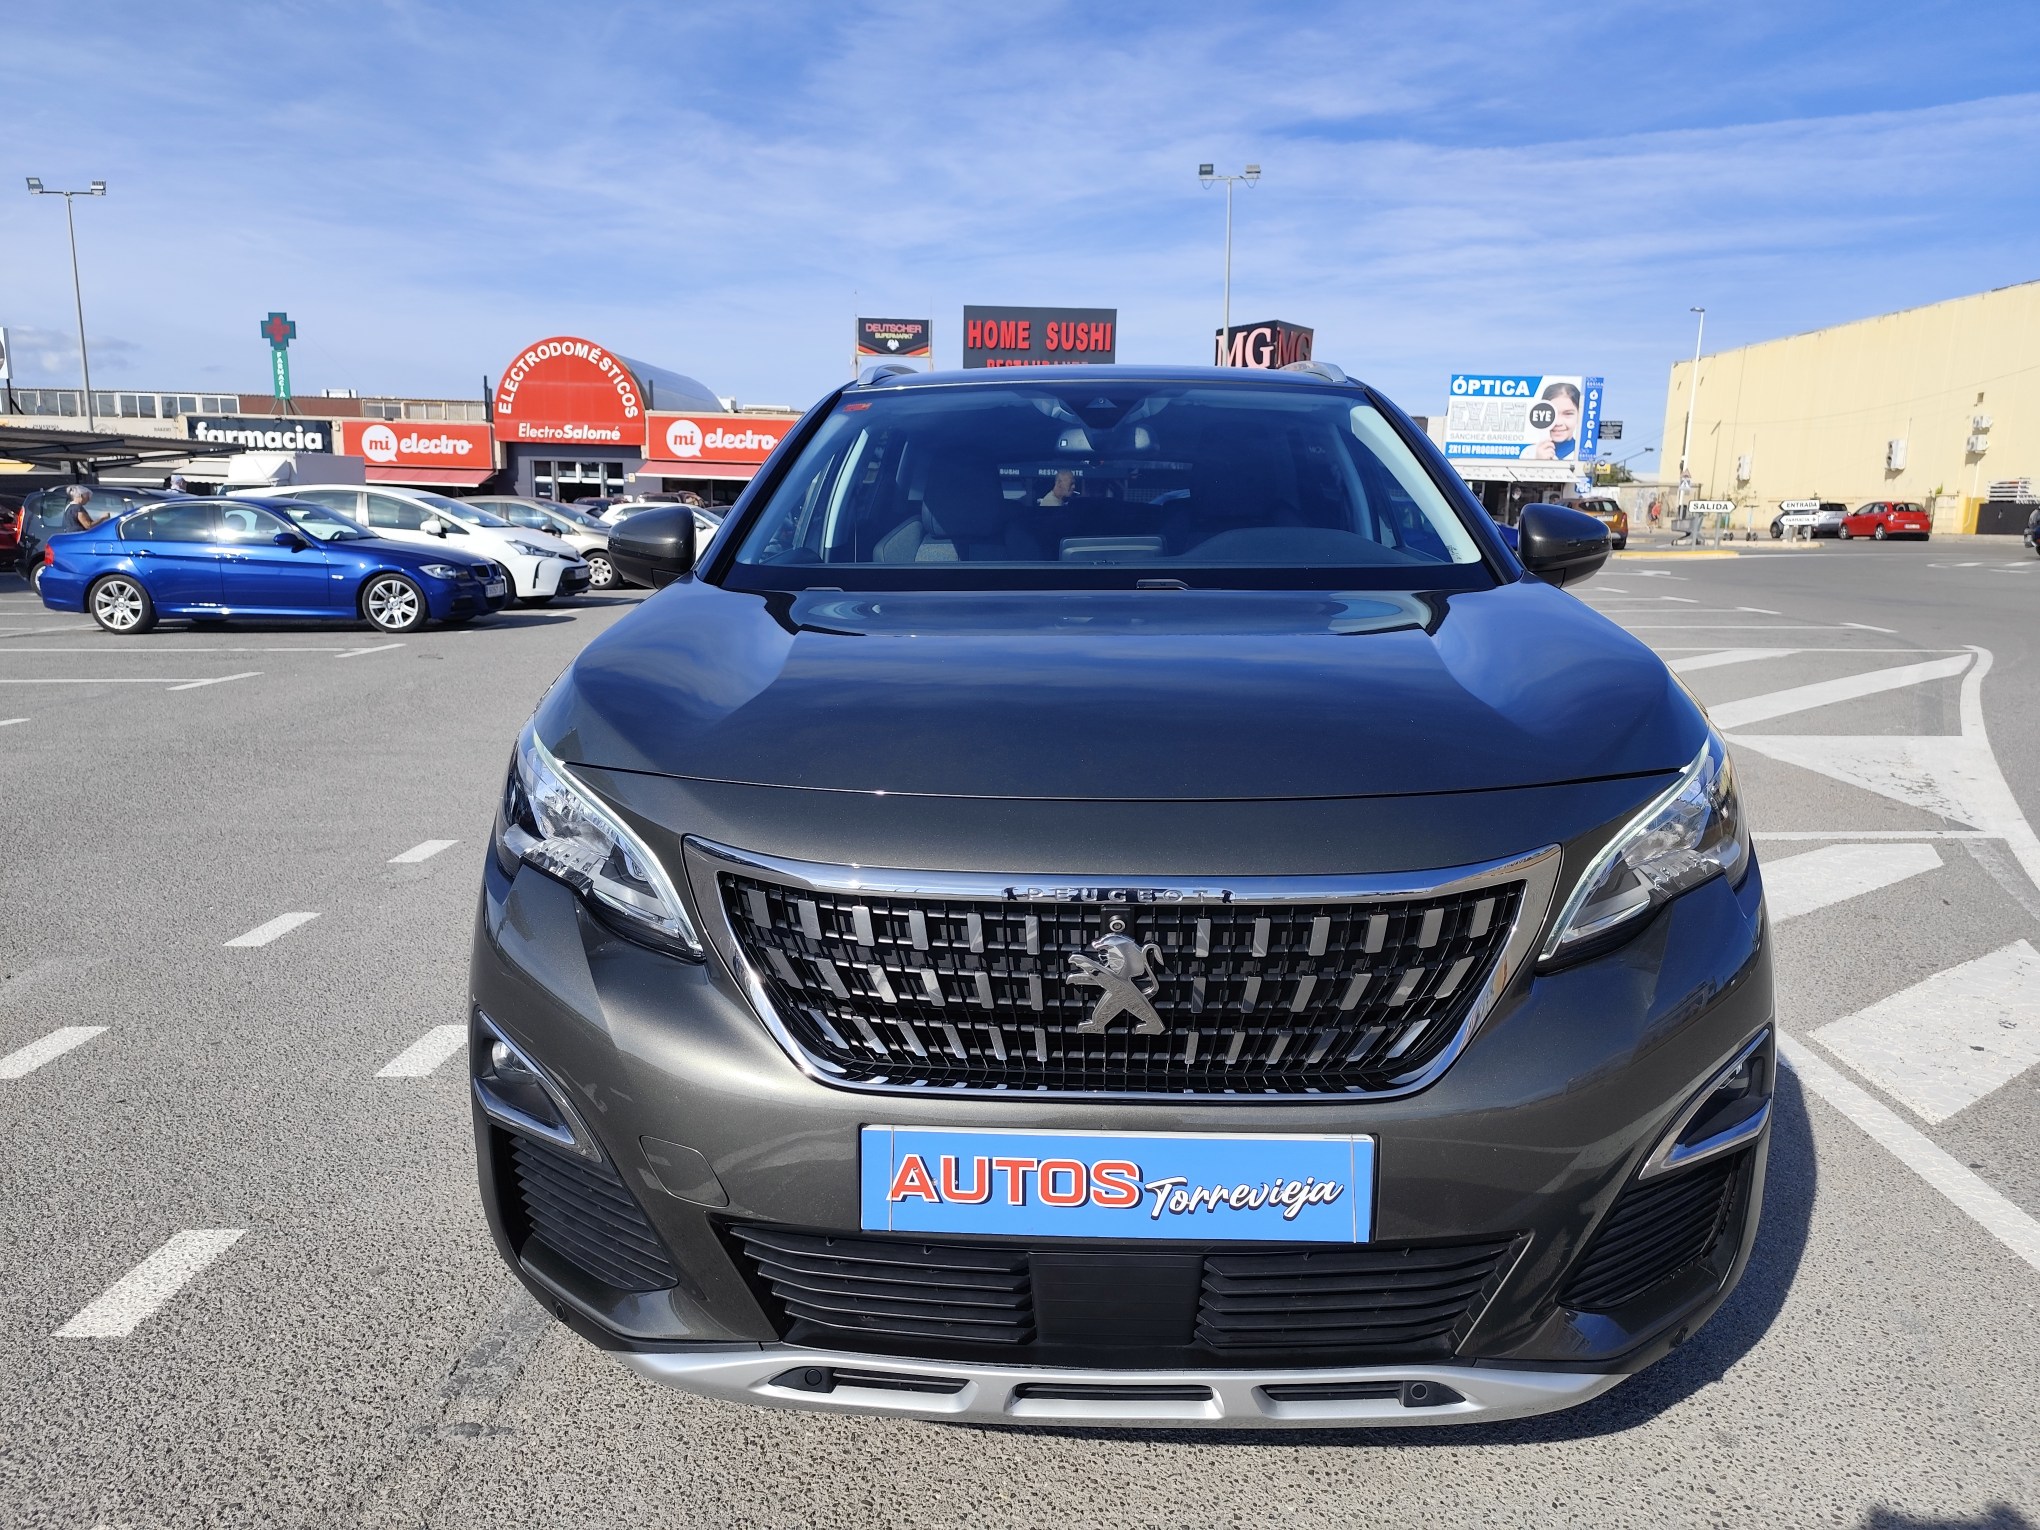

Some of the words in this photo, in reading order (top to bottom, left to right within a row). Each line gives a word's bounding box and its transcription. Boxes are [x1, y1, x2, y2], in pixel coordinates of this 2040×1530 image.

[865, 323, 922, 333] DEUTSCHER
[967, 319, 1030, 350] HOME
[1045, 321, 1112, 352] SUSHI
[1215, 327, 1274, 369] MG
[498, 341, 639, 419] ELECTRODOMÉSTICOS
[1452, 376, 1531, 396] ÓPTICA
[1449, 401, 1527, 433] EXAM
[1532, 409, 1552, 422] EYE
[195, 421, 323, 450] farmacia
[518, 422, 621, 441] ElectroSalomé
[673, 430, 696, 446] mi
[704, 427, 778, 450] electro
[1487, 433, 1525, 441] BARREDO
[369, 436, 391, 451] mi
[400, 432, 473, 455] electro
[1462, 445, 1471, 454] EN
[1472, 445, 1521, 456] PROGRESIVOS
[1693, 503, 1729, 511] SALIDA
[1026, 887, 1210, 903] PEUGEOT
[886, 1154, 1143, 1208] AUTOS
[1145, 1174, 1345, 1220] Torrevieja
